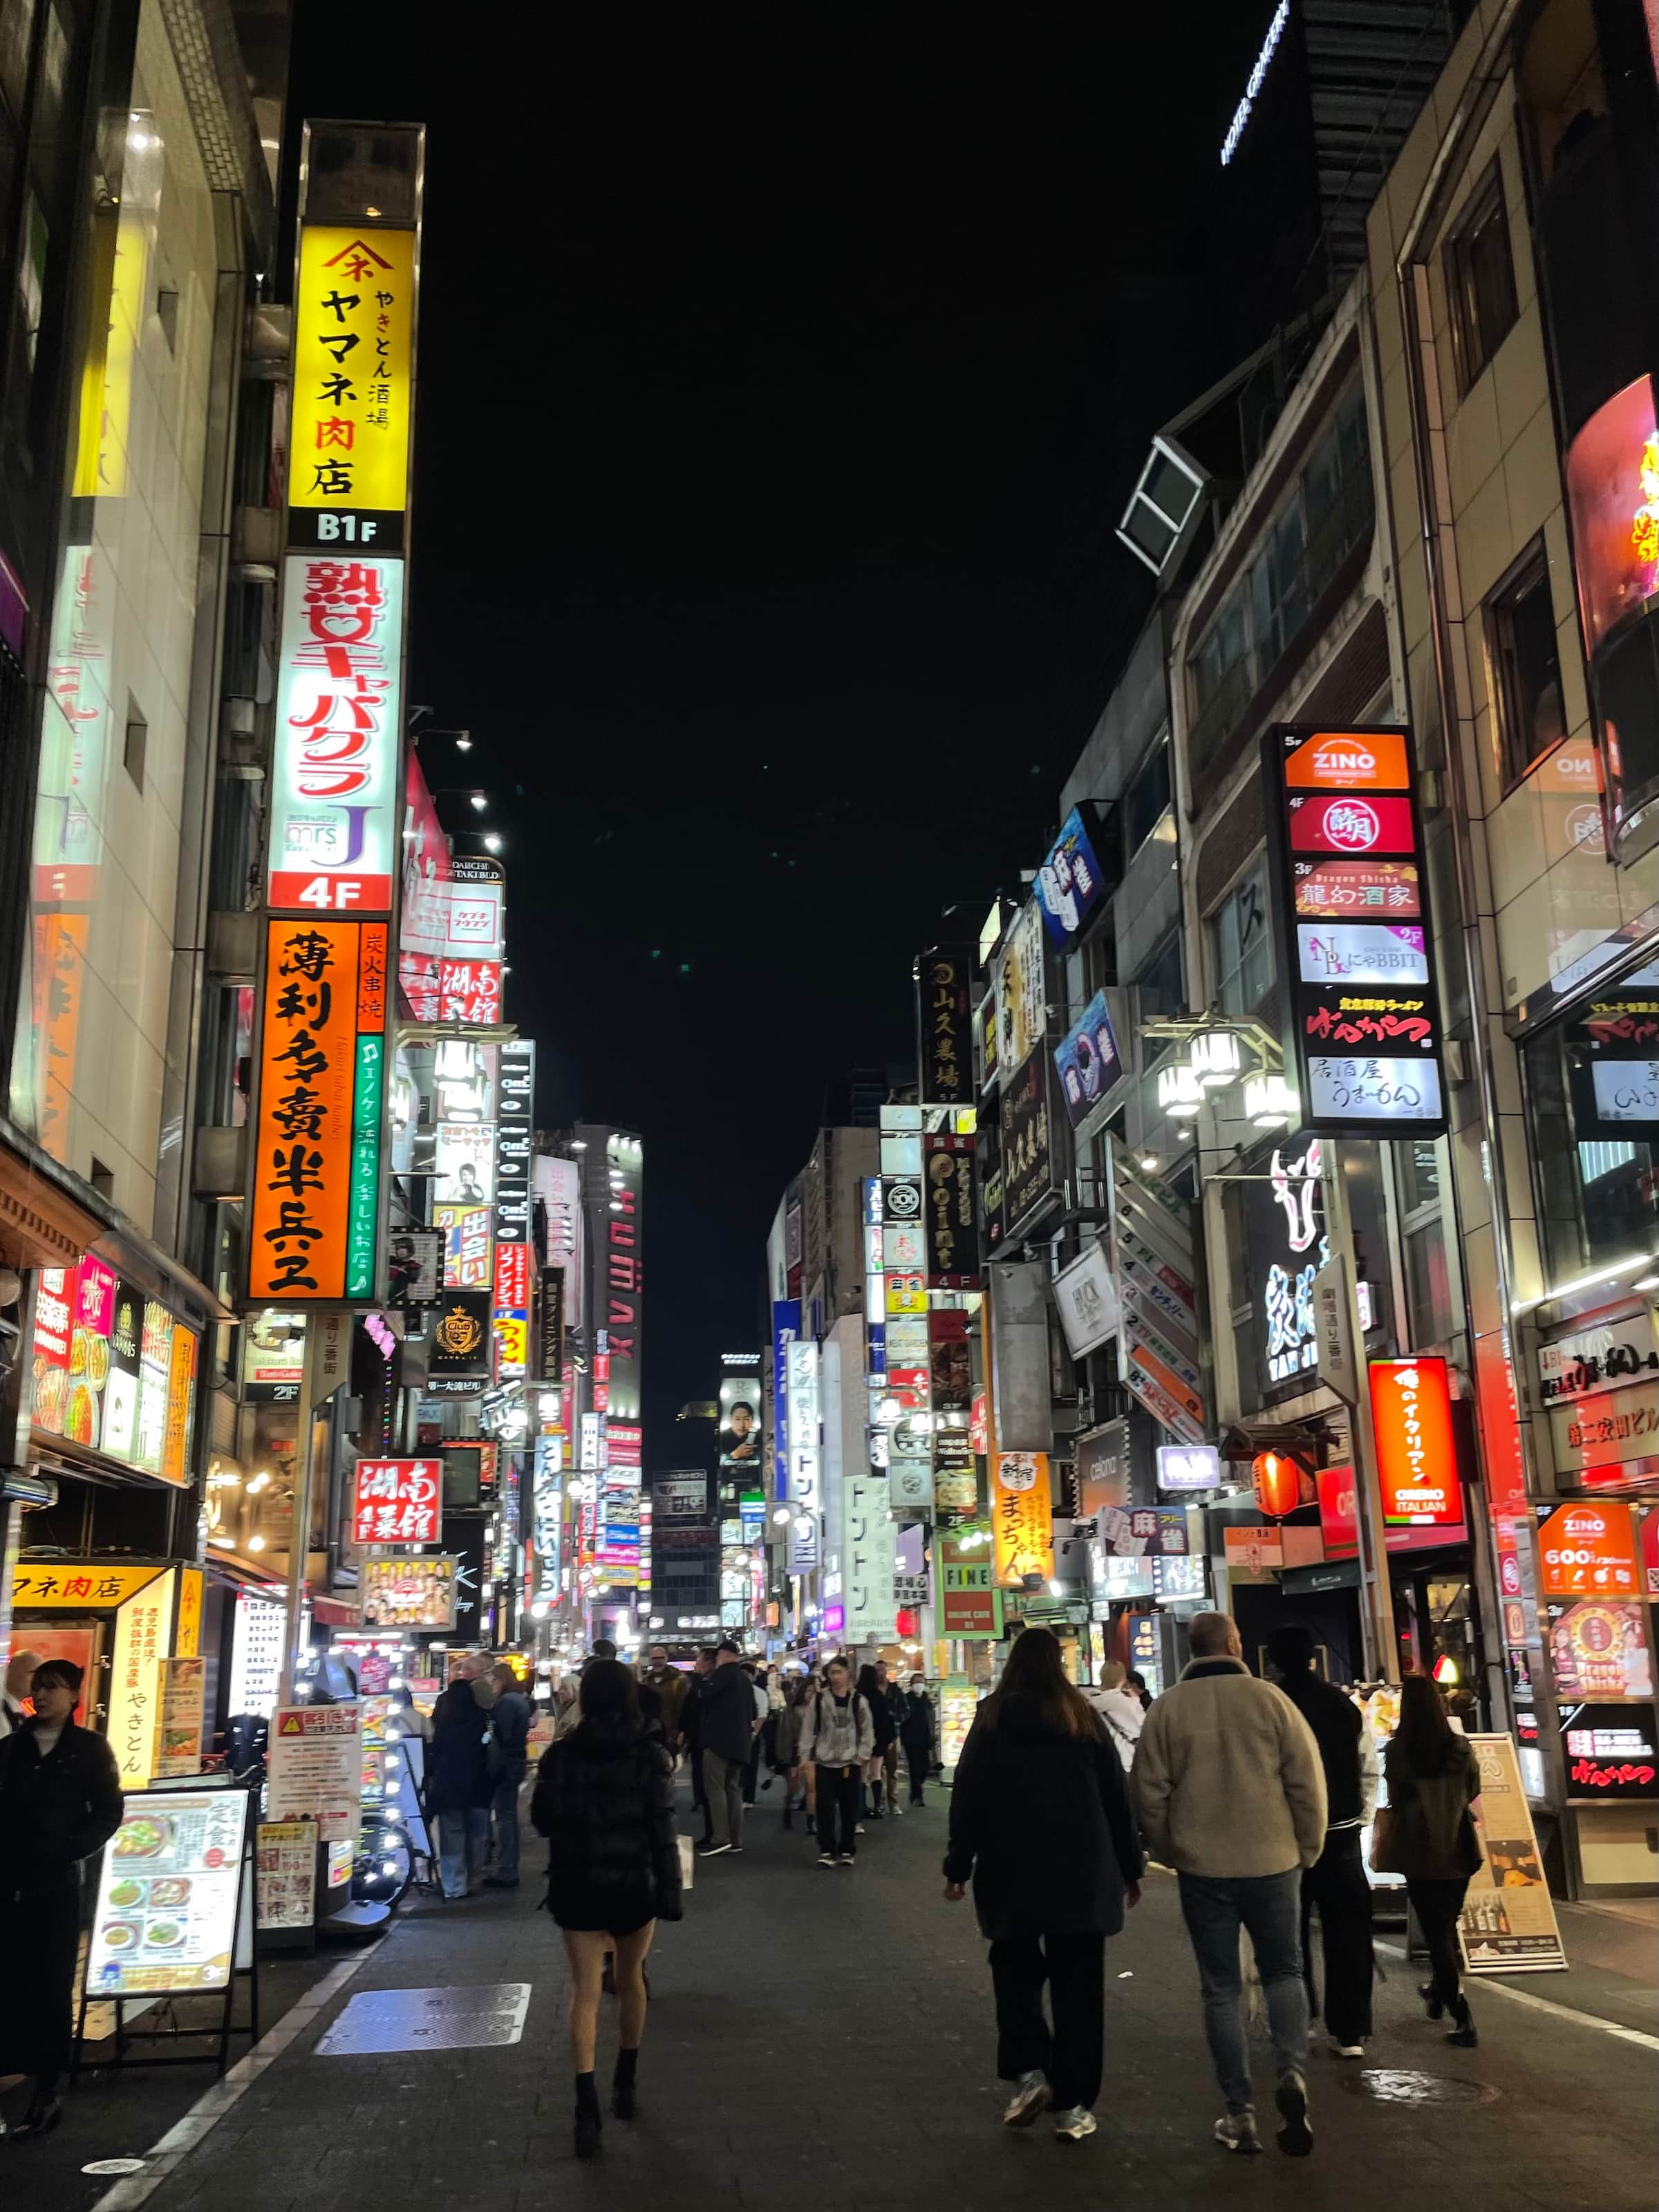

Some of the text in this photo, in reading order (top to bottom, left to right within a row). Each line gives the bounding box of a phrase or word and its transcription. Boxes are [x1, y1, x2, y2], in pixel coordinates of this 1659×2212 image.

[364, 289, 395, 430] やきとん酒場
[306, 289, 362, 496] ヤマネ肉店
[317, 513, 377, 543] B1F
[288, 561, 395, 798] 熟女キャバクラ
[1285, 737, 1302, 747] 5F
[1313, 753, 1375, 769] ZINO
[1289, 798, 1304, 807] 4F
[1295, 863, 1313, 874] 3F
[1315, 874, 1356, 883] Dragon
[299, 876, 362, 910] 4F
[1301, 883, 1415, 906] 龍幻酒家
[1400, 928, 1422, 944] 2F
[358, 933, 384, 1019] 炭火串焼
[443, 964, 498, 996] 湖南
[1313, 1059, 1383, 1079] 居酒屋
[462, 1211, 487, 1284] 出会い
[274, 1386, 299, 1400] 2F
[1394, 1368, 1425, 1482] 俺のイタリアン
[359, 1461, 436, 1503] 湖南
[1396, 1501, 1446, 1512] ITALIAN
[373, 1504, 434, 1539] 菜館
[948, 1516, 966, 1526] 2F
[1562, 1519, 1605, 1531] ZINO
[1545, 1550, 1590, 1564] 600
[122, 1693, 147, 1772] やきとん
